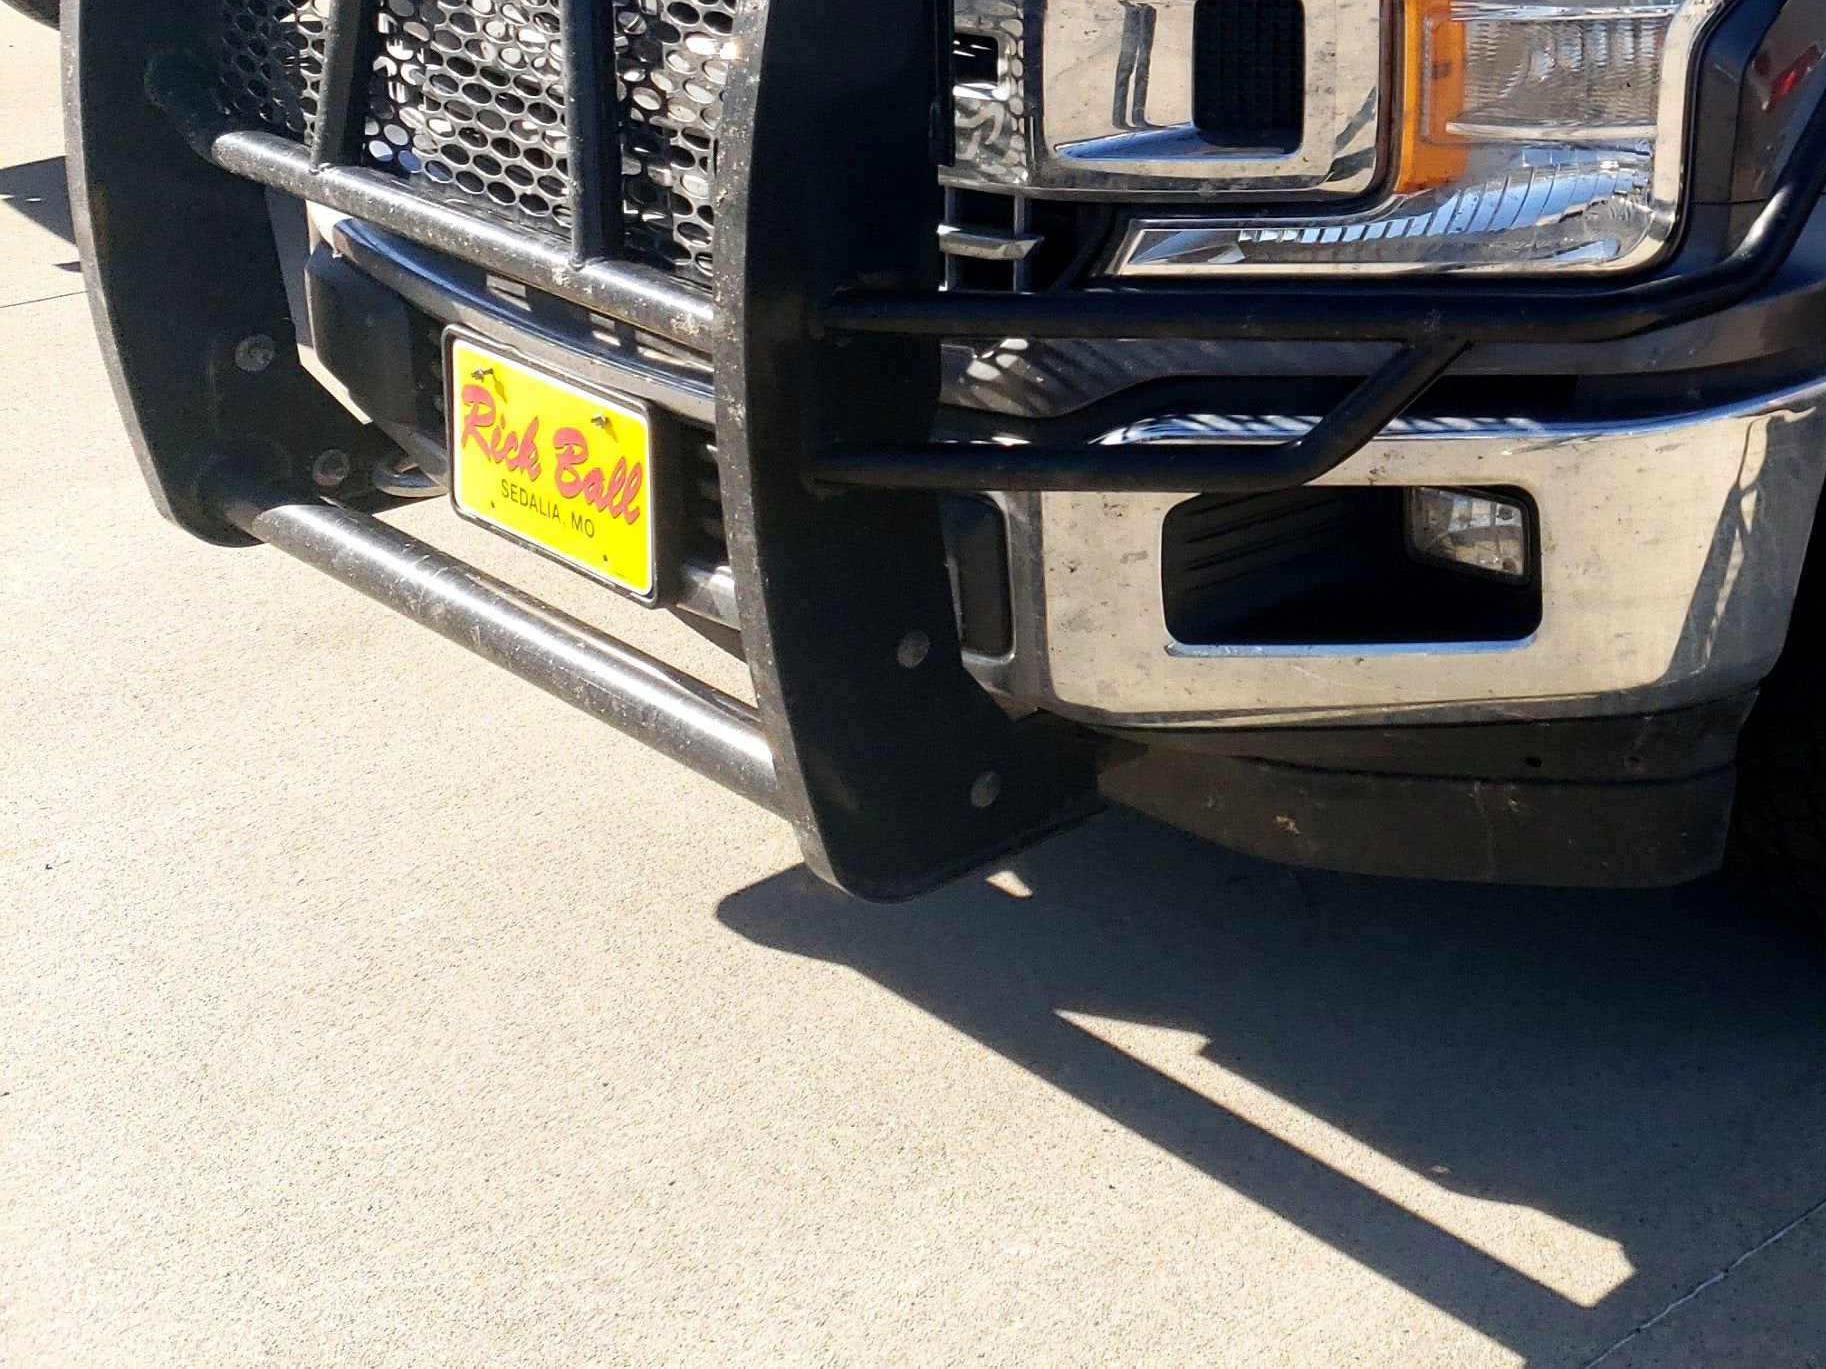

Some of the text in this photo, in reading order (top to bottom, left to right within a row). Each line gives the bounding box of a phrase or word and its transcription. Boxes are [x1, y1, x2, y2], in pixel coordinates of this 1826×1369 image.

[461, 384, 642, 524] Rick Ball
[571, 514, 596, 538] MO
